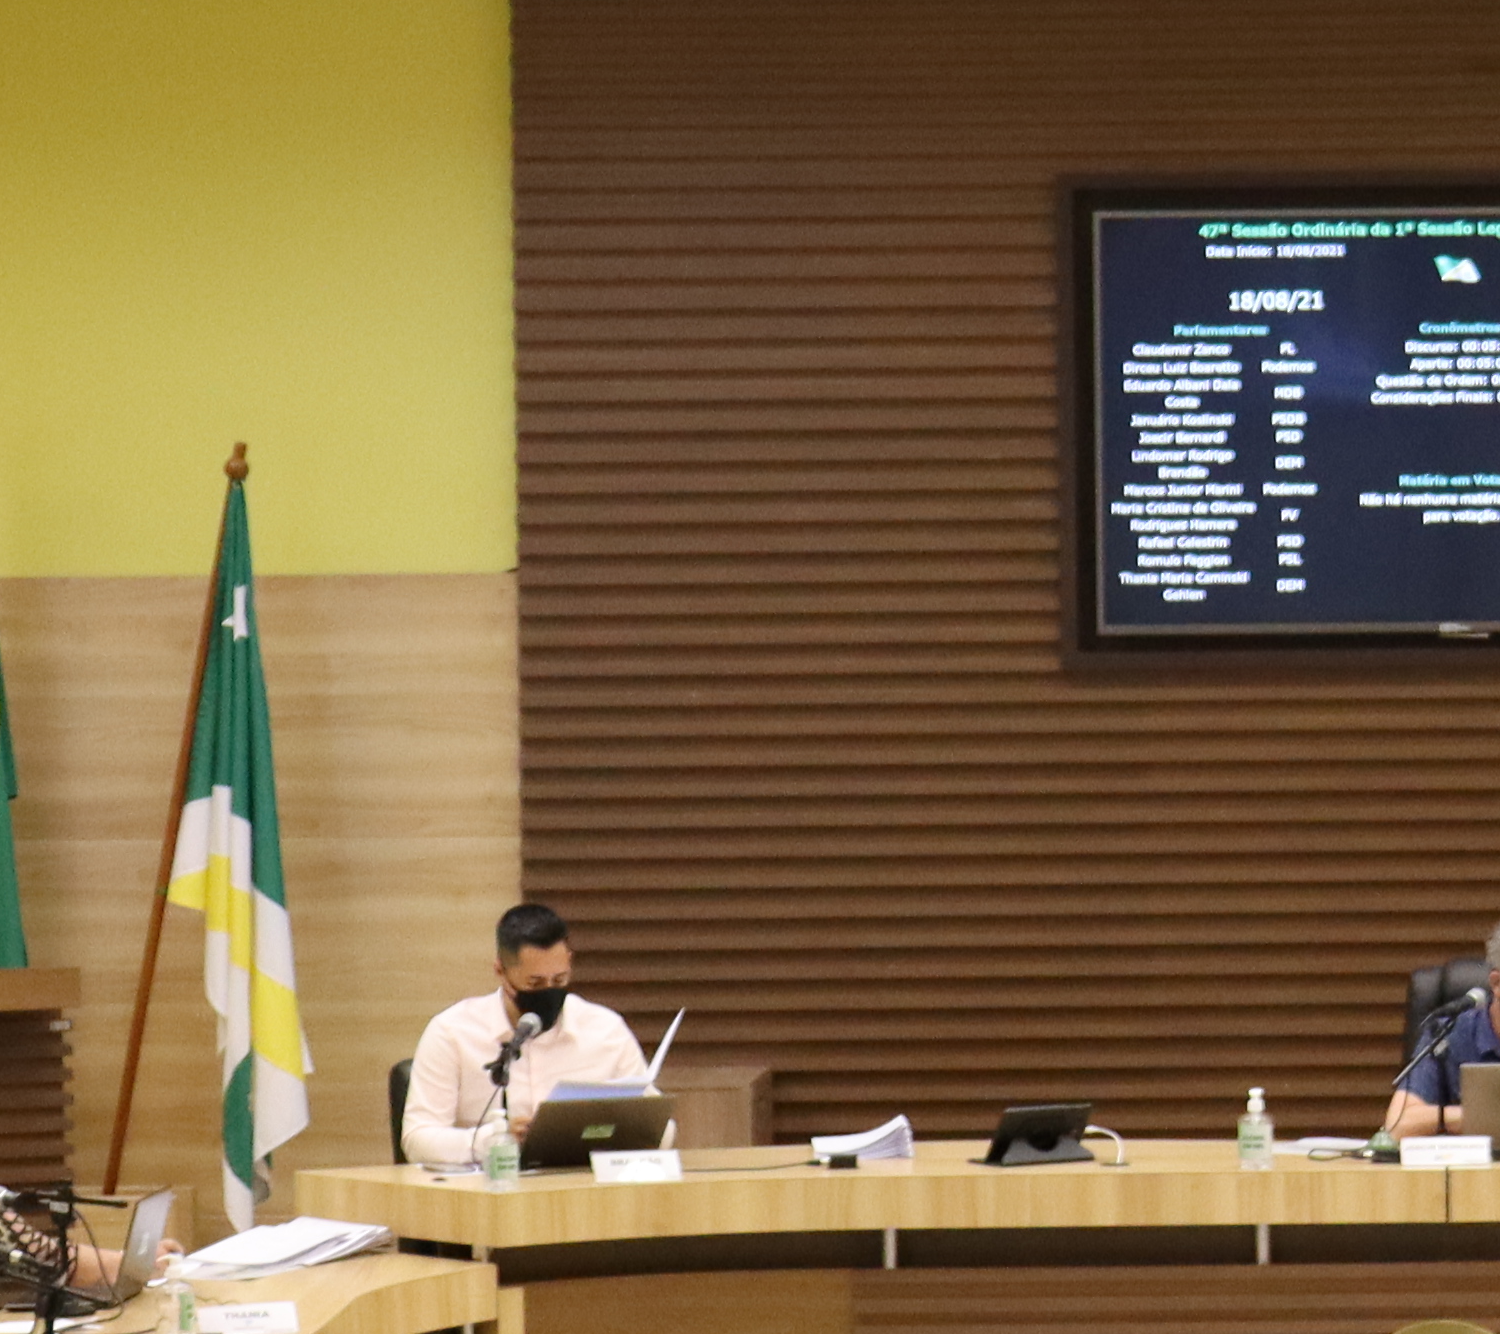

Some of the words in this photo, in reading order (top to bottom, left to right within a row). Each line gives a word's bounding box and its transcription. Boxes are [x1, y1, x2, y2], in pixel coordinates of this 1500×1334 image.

[1199, 223, 1229, 238] 47ª
[1231, 222, 1288, 238] Sessão
[1291, 221, 1368, 237] Ordinária
[1370, 222, 1392, 237] da
[1395, 221, 1415, 236] 1ª
[1417, 220, 1476, 237] Sessão
[1205, 245, 1235, 259] Data
[1236, 244, 1273, 258] Início:
[1276, 243, 1346, 258] 18/08/2021
[1228, 289, 1325, 314] 18/08/21
[1173, 324, 1270, 337] Parlamentares
[1132, 342, 1192, 357] Claudemir
[1193, 342, 1233, 357] Zanco
[1280, 341, 1298, 357] PL
[1404, 339, 1459, 354] Discurso:
[1123, 361, 1162, 375] Dirceu
[1163, 361, 1189, 375] Luiz
[1189, 360, 1243, 375] Boaretto
[1261, 359, 1317, 374] Podemos
[1409, 356, 1454, 372] Aparte:
[1123, 379, 1173, 393] Eduardo
[1173, 378, 1211, 392] Albani
[1212, 378, 1243, 392] Dala
[1375, 373, 1425, 389] Questão
[1426, 373, 1443, 388] de
[1443, 372, 1489, 387] Ordem:
[1274, 384, 1305, 400] MDB
[1370, 390, 1454, 406] Considerações
[1455, 390, 1494, 405] Finais:
[1164, 394, 1201, 409] Costa
[1130, 413, 1181, 427] Januário
[1271, 410, 1308, 426] PSDB
[1175, 430, 1228, 445] Bernardi
[1275, 428, 1304, 444] PSD
[1131, 449, 1187, 464] Lindomar
[1188, 449, 1236, 465] Rodrigo
[1275, 454, 1305, 471] DEM
[1158, 465, 1209, 480] Brandão
[1399, 473, 1448, 487] Matéria
[1449, 475, 1471, 487] em
[1123, 483, 1167, 497] Marcos
[1205, 482, 1244, 496] Marini
[1262, 481, 1318, 496] Podemos
[1359, 492, 1384, 507] Não
[1385, 492, 1402, 506] há
[1403, 492, 1459, 506] nenhuma
[1111, 501, 1145, 515] Maria
[1145, 501, 1192, 515] Cristina
[1192, 501, 1209, 515] de
[1209, 500, 1257, 514] Oliveira
[1280, 507, 1300, 522] PV
[1422, 510, 1452, 525] para
[1130, 518, 1189, 534] Rodrigues
[1189, 518, 1238, 532] Hamera
[1137, 535, 1176, 550] Rafael
[1176, 535, 1232, 549] Celestrin
[1276, 533, 1305, 549] PSD
[1137, 553, 1183, 567] Romulo
[1183, 552, 1232, 569] Faggion
[1278, 551, 1304, 567] PSL
[1118, 570, 1159, 585] Thania
[1160, 570, 1195, 585] Maria
[1195, 570, 1251, 585] Caminski
[1276, 578, 1306, 593] DEM
[1162, 587, 1207, 602] Gehlen
